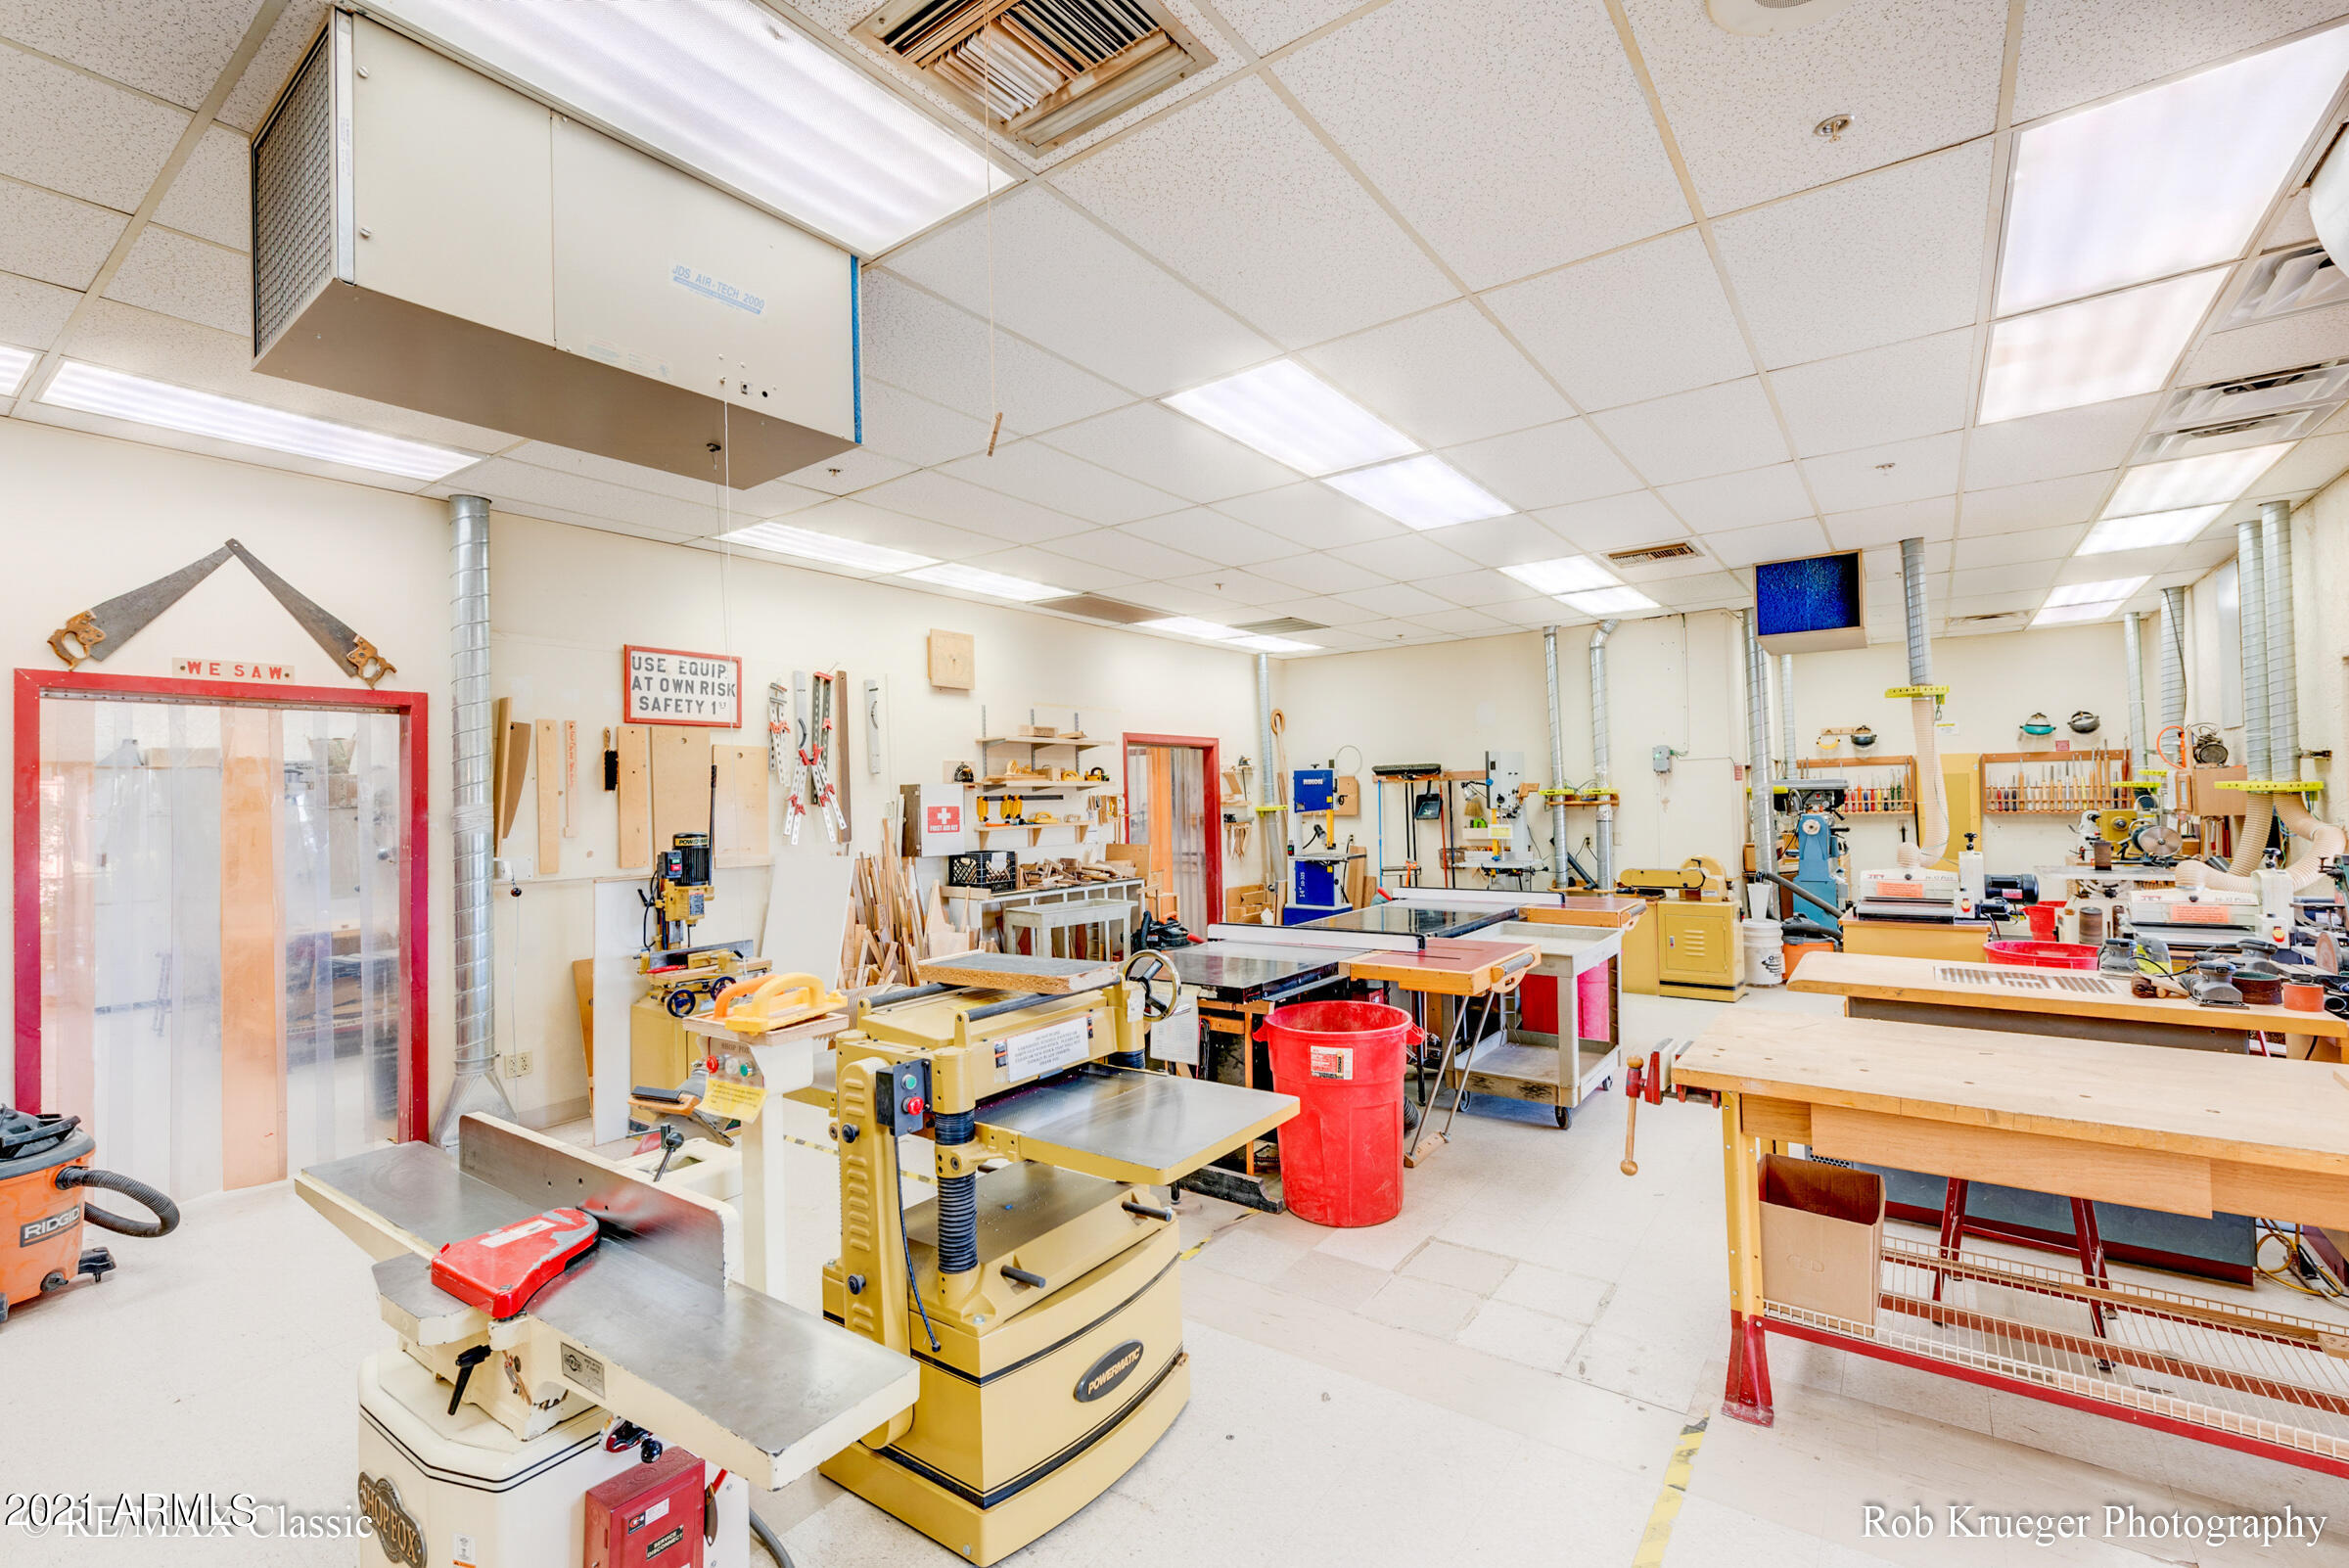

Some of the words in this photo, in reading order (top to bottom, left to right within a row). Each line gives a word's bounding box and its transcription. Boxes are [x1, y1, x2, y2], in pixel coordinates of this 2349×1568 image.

[672, 265, 691, 280] JDS
[744, 294, 764, 308] 2000
[187, 661, 221, 676] WE
[234, 665, 282, 679] SAW
[631, 656, 667, 673] USE
[631, 675, 653, 691] AT
[660, 677, 694, 694] OWN
[700, 680, 736, 698] RISK
[639, 696, 705, 714] SAFETY
[24, 1207, 80, 1239] RIDGID
[1087, 1347, 1140, 1395] POWERMATIC
[360, 1480, 389, 1533] SHOP
[391, 1509, 418, 1564] FOX
[647, 1534, 683, 1558] DISCONNECT
[654, 1531, 677, 1548] SERVICE
